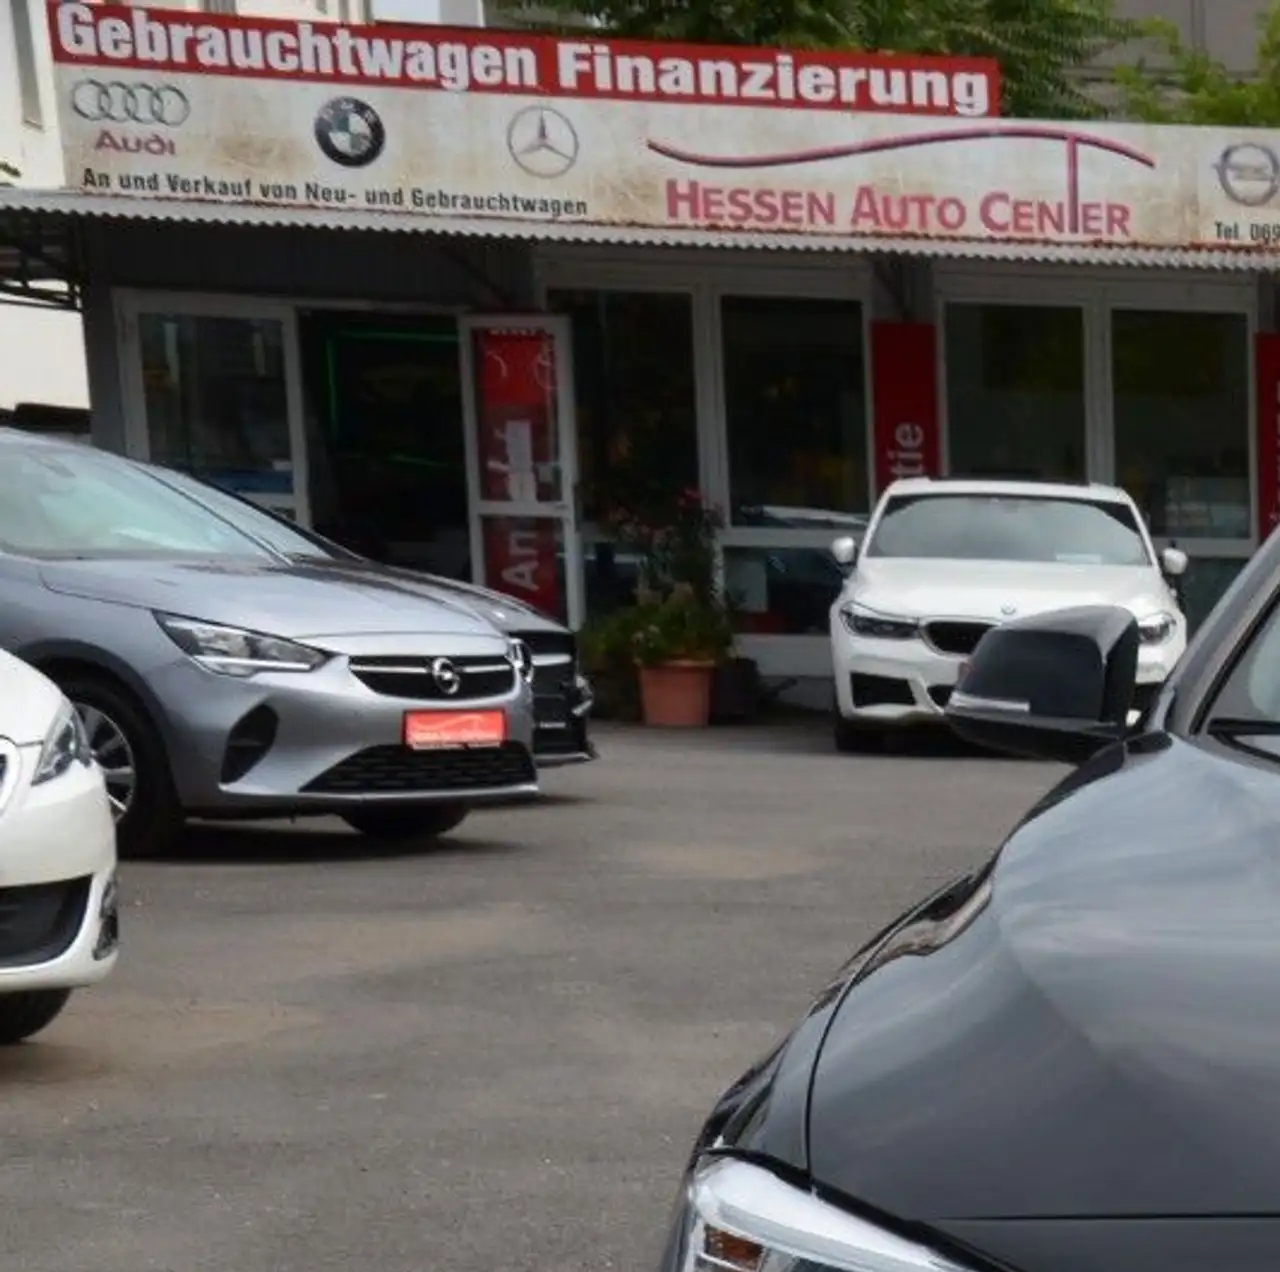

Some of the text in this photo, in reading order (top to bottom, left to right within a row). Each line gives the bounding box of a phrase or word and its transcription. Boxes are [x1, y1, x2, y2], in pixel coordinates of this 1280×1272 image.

[57, 1, 989, 117] Gebrauchtwagen Finanzierung
[94, 129, 177, 156] Audi
[83, 168, 588, 216] An und Verkauf von Neu- und Gebrauchtwagen
